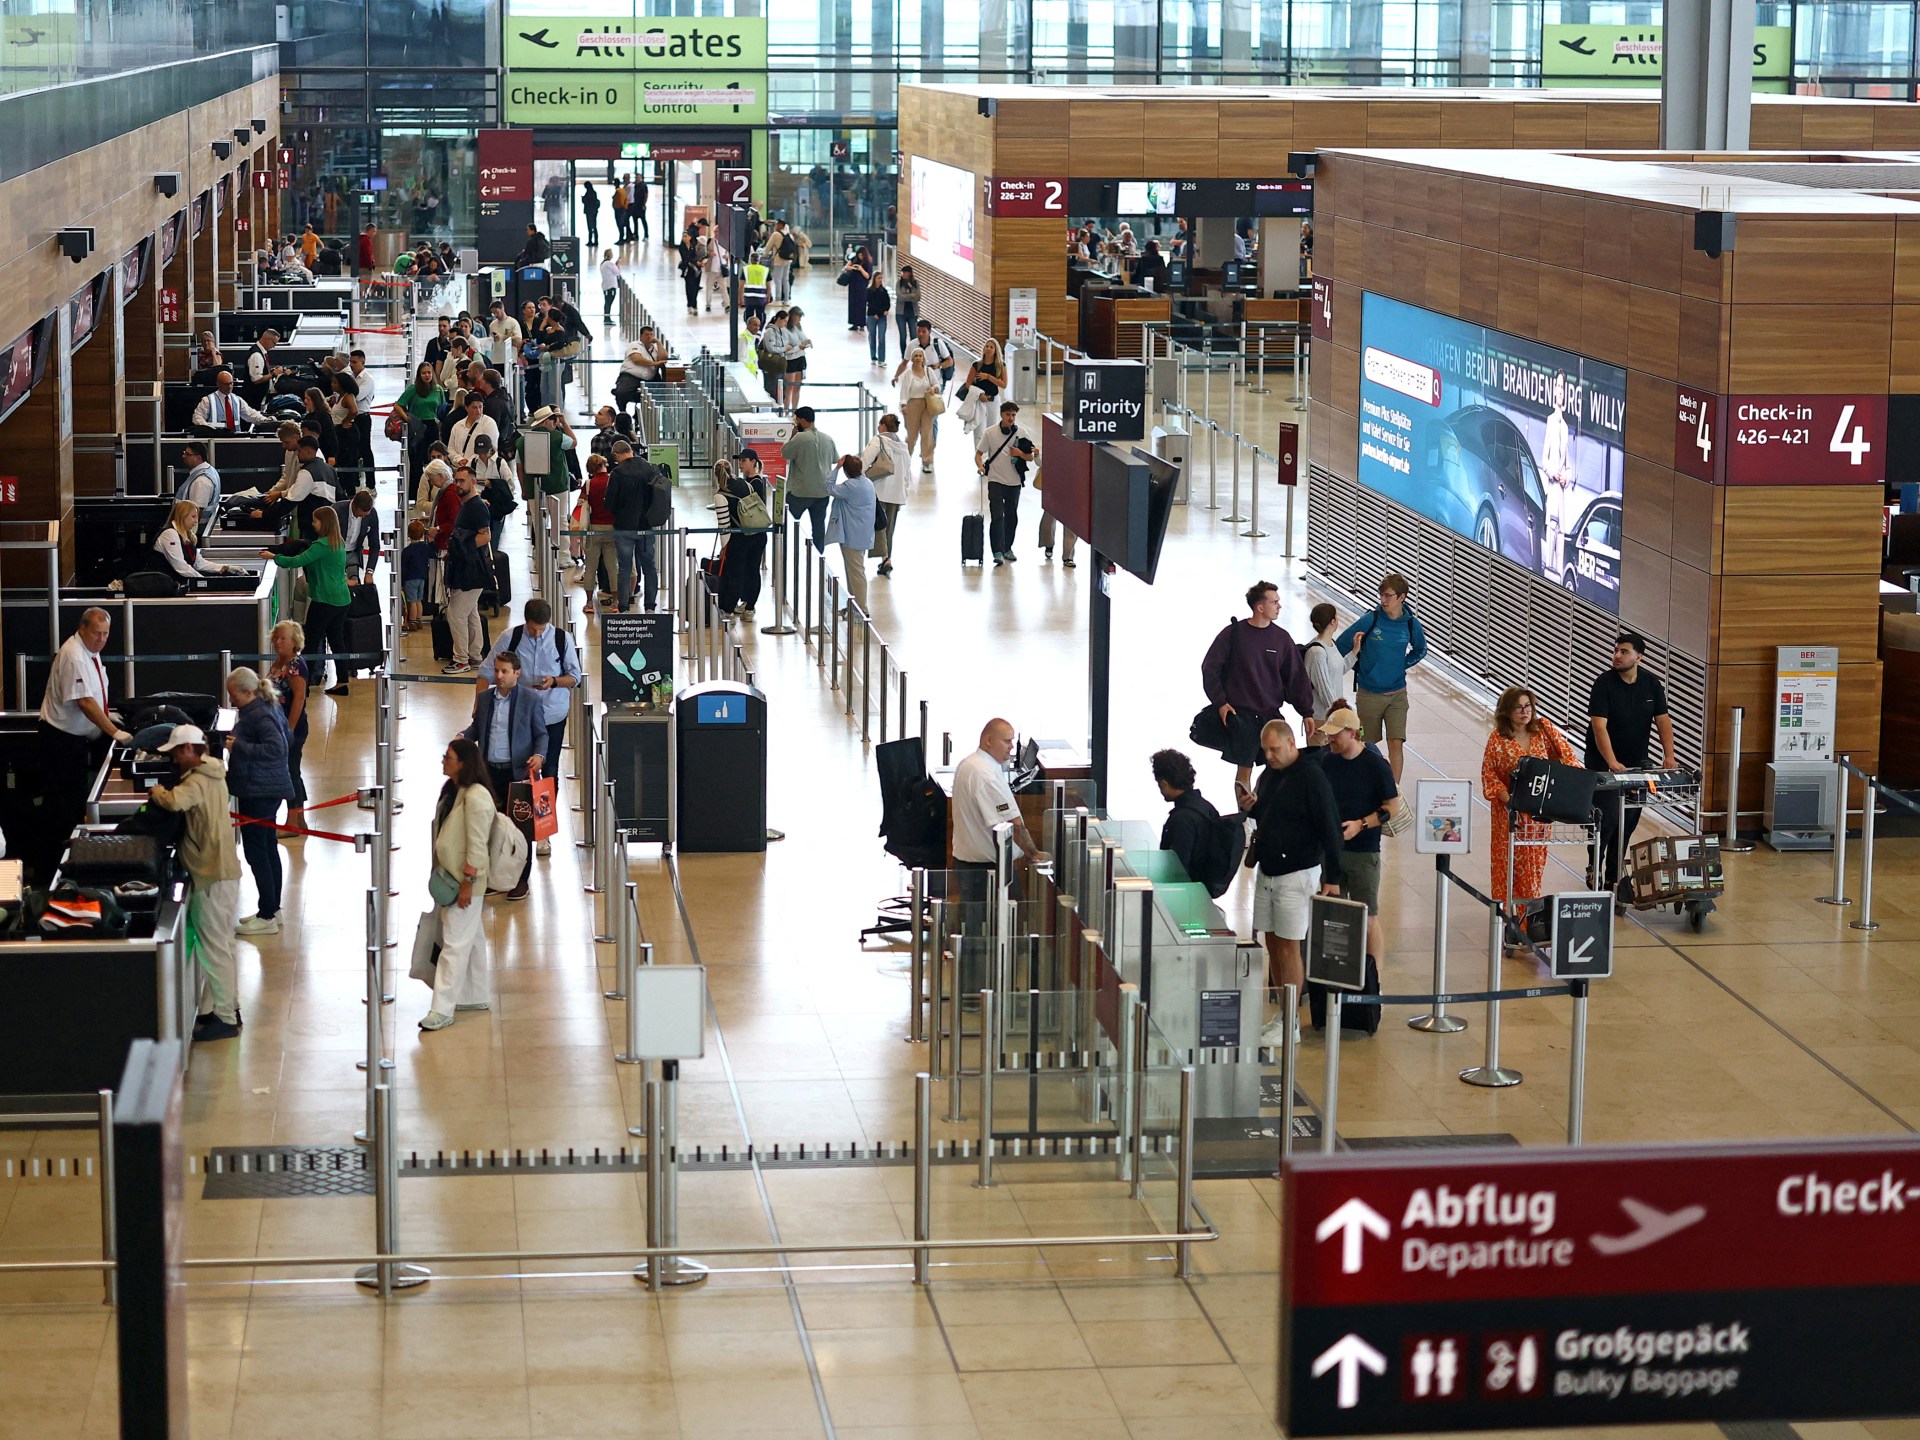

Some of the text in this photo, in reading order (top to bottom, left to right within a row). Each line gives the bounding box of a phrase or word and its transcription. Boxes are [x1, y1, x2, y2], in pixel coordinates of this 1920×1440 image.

[576, 25, 742, 58] All Gates
[579, 35, 666, 44] Geschlossen Closed
[1612, 34, 1658, 65] All
[511, 86, 598, 105] Check-in
[732, 174, 750, 202] 2
[1000, 181, 1035, 190] Check-in
[1044, 181, 1063, 210] 2
[1323, 285, 1332, 328] 4
[1464, 349, 1498, 388] BERLIN
[1589, 389, 1626, 433] WILLY
[1078, 398, 1142, 418] Priority
[1679, 394, 1698, 410] Check-in
[1737, 403, 1813, 421] Check-in
[744, 428, 759, 436] BER
[1078, 418, 1117, 433] Lane
[1696, 401, 1712, 463] 4
[1829, 405, 1871, 465] 4
[1577, 549, 1596, 581] BER
[607, 618, 642, 626] Flüssigkeiten
[619, 625, 648, 633] entsorgen!
[1800, 651, 1816, 659] BER
[1573, 902, 1603, 912] Priority
[1347, 995, 1363, 1003] BER
[1437, 995, 1453, 1003] BER
[1526, 989, 1541, 997] BER
[1403, 1182, 1557, 1234] Abflug
[1401, 1237, 1575, 1277] Departure
[1555, 1322, 1749, 1365] Großgepäck
[1554, 1366, 1740, 1399] Bulky Baggage
